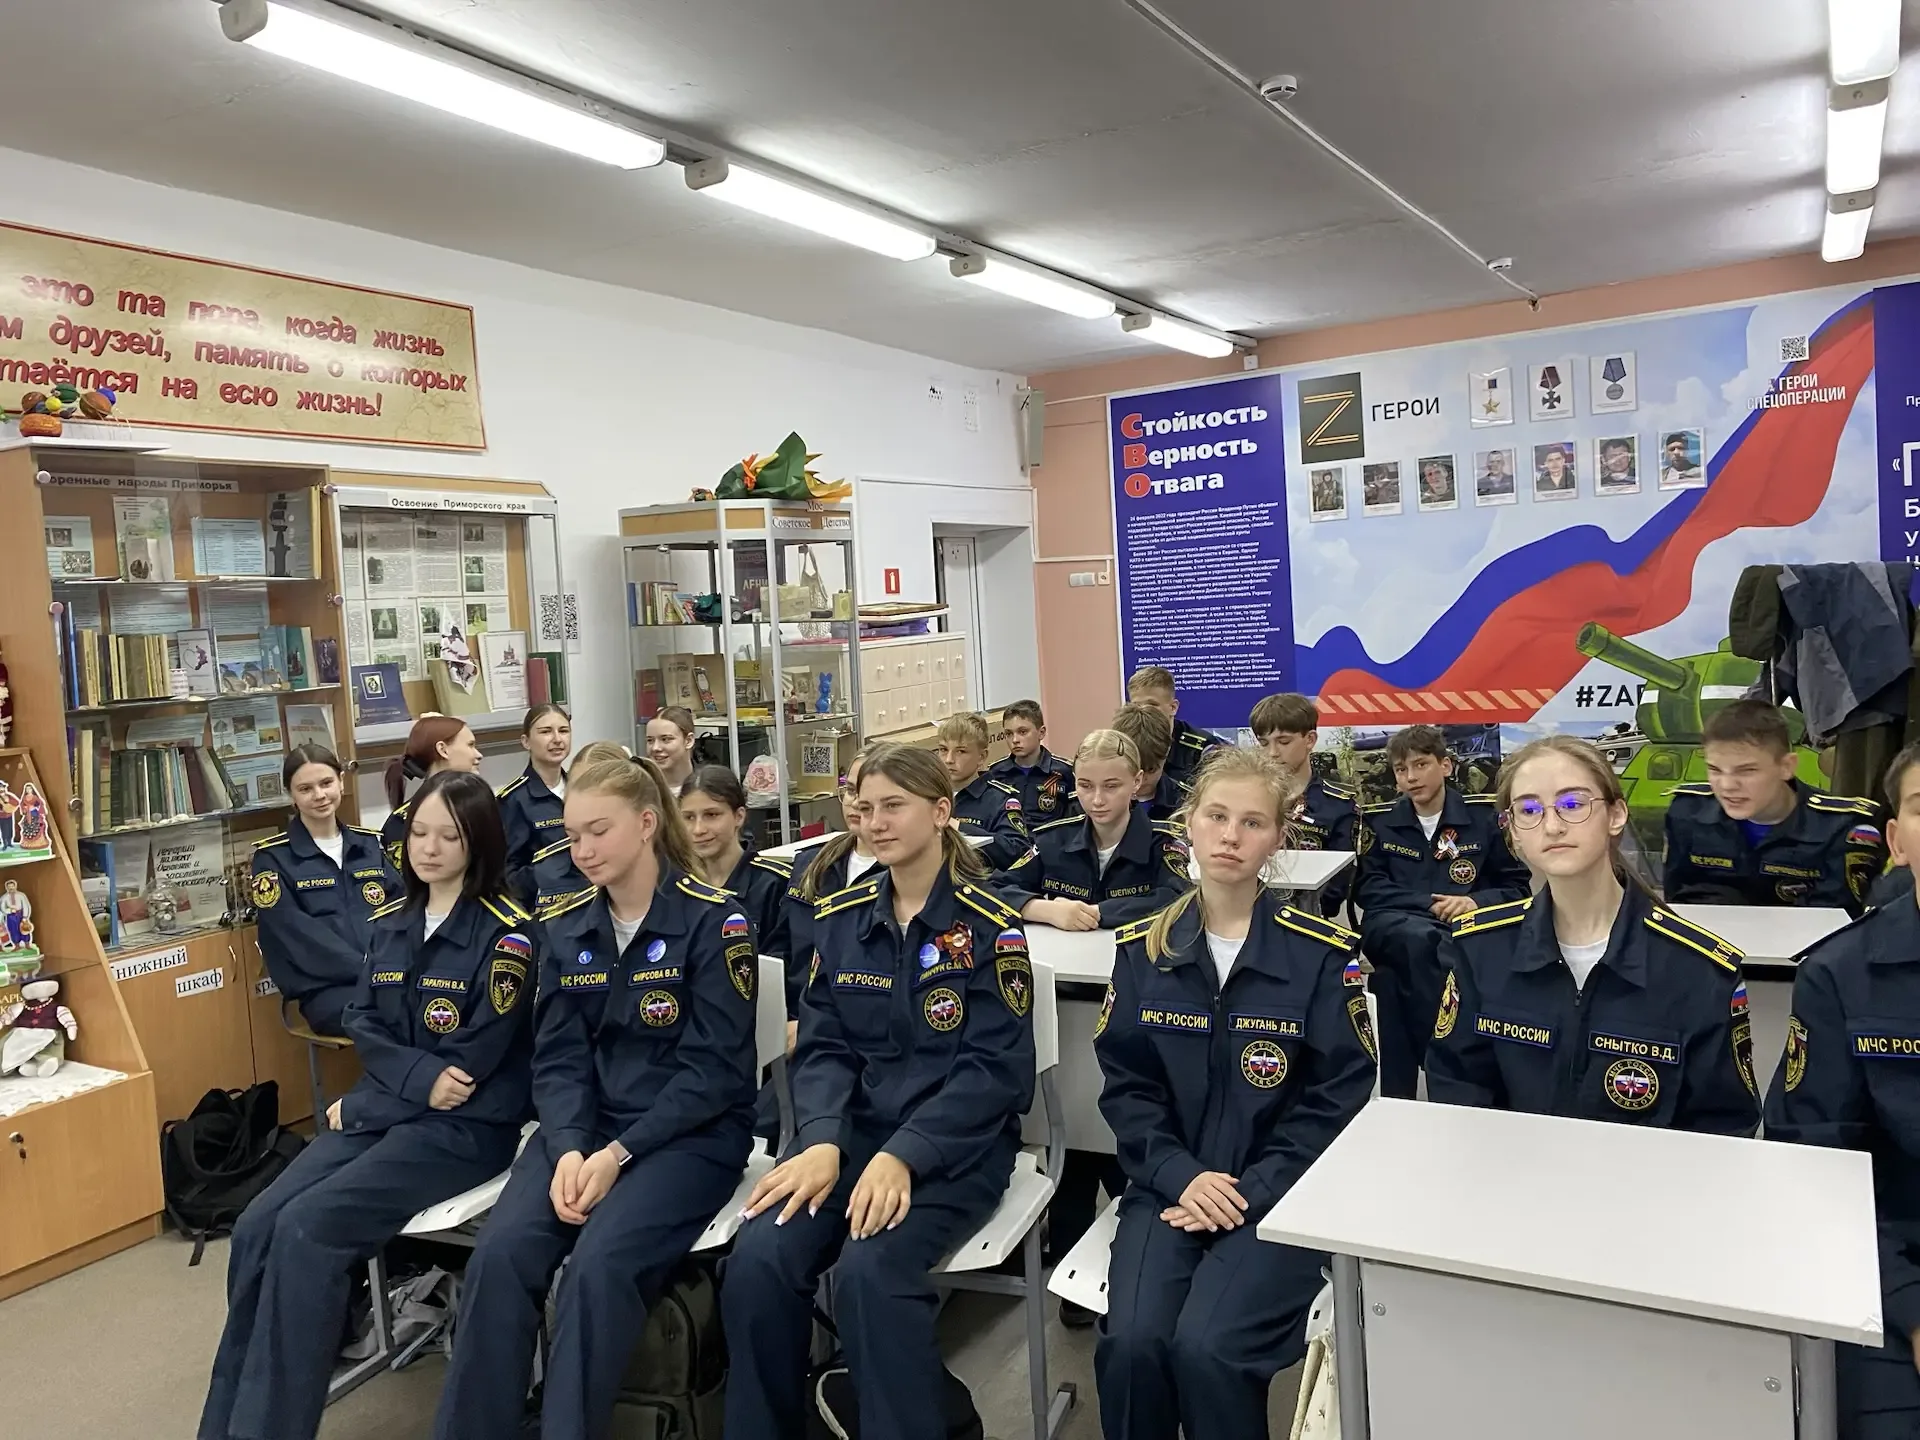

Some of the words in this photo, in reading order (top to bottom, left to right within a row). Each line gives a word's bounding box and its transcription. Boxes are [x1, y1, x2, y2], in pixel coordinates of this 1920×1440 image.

[20, 273, 94, 307] это
[117, 289, 166, 318] та
[285, 316, 357, 345] когда
[372, 329, 445, 357] жизнь
[48, 313, 172, 363] друзей,
[193, 338, 310, 375] память
[326, 359, 344, 379] о
[360, 361, 468, 393] которых
[1779, 373, 1818, 391] ГЕРОИ
[161, 374, 197, 399] на
[218, 380, 279, 407] всю
[295, 389, 382, 417] жизнь!
[1747, 386, 1846, 410] СПЕЦОПЕРАЦИИ
[1371, 397, 1440, 422] ГЕРОИ
[1121, 405, 1268, 439] Стойкость
[1124, 438, 1258, 469] Верность
[40, 474, 110, 487] оренные
[118, 477, 167, 489] народы
[171, 479, 232, 491] Приморья
[1124, 472, 1224, 498] Отвага
[391, 498, 438, 509] Освоение
[443, 499, 502, 511] Приморского
[506, 502, 526, 511] края
[1044, 879, 1060, 890] МЧС
[1060, 882, 1089, 897] РОССИИ
[1110, 887, 1137, 897] ШЕПКО
[113, 948, 186, 979] нижный
[177, 969, 222, 994] шкаф
[378, 972, 403, 983] РОССИИ
[574, 972, 607, 985] РОССИИ
[836, 973, 853, 985] МЧС
[855, 974, 892, 989] РОССИИ
[1141, 1010, 1163, 1024] МЧС
[1166, 1012, 1208, 1029] РОССИИ
[1236, 1018, 1278, 1031] ДЖУГАНЬ
[1280, 1021, 1299, 1034] Д.Д.
[1477, 1018, 1500, 1034] МЧС
[1503, 1024, 1550, 1045] РОССИИ
[1595, 1037, 1648, 1056] СНЫТКО
[1651, 1045, 1676, 1061] В.Д.
[1857, 1037, 1888, 1053] МЧС
